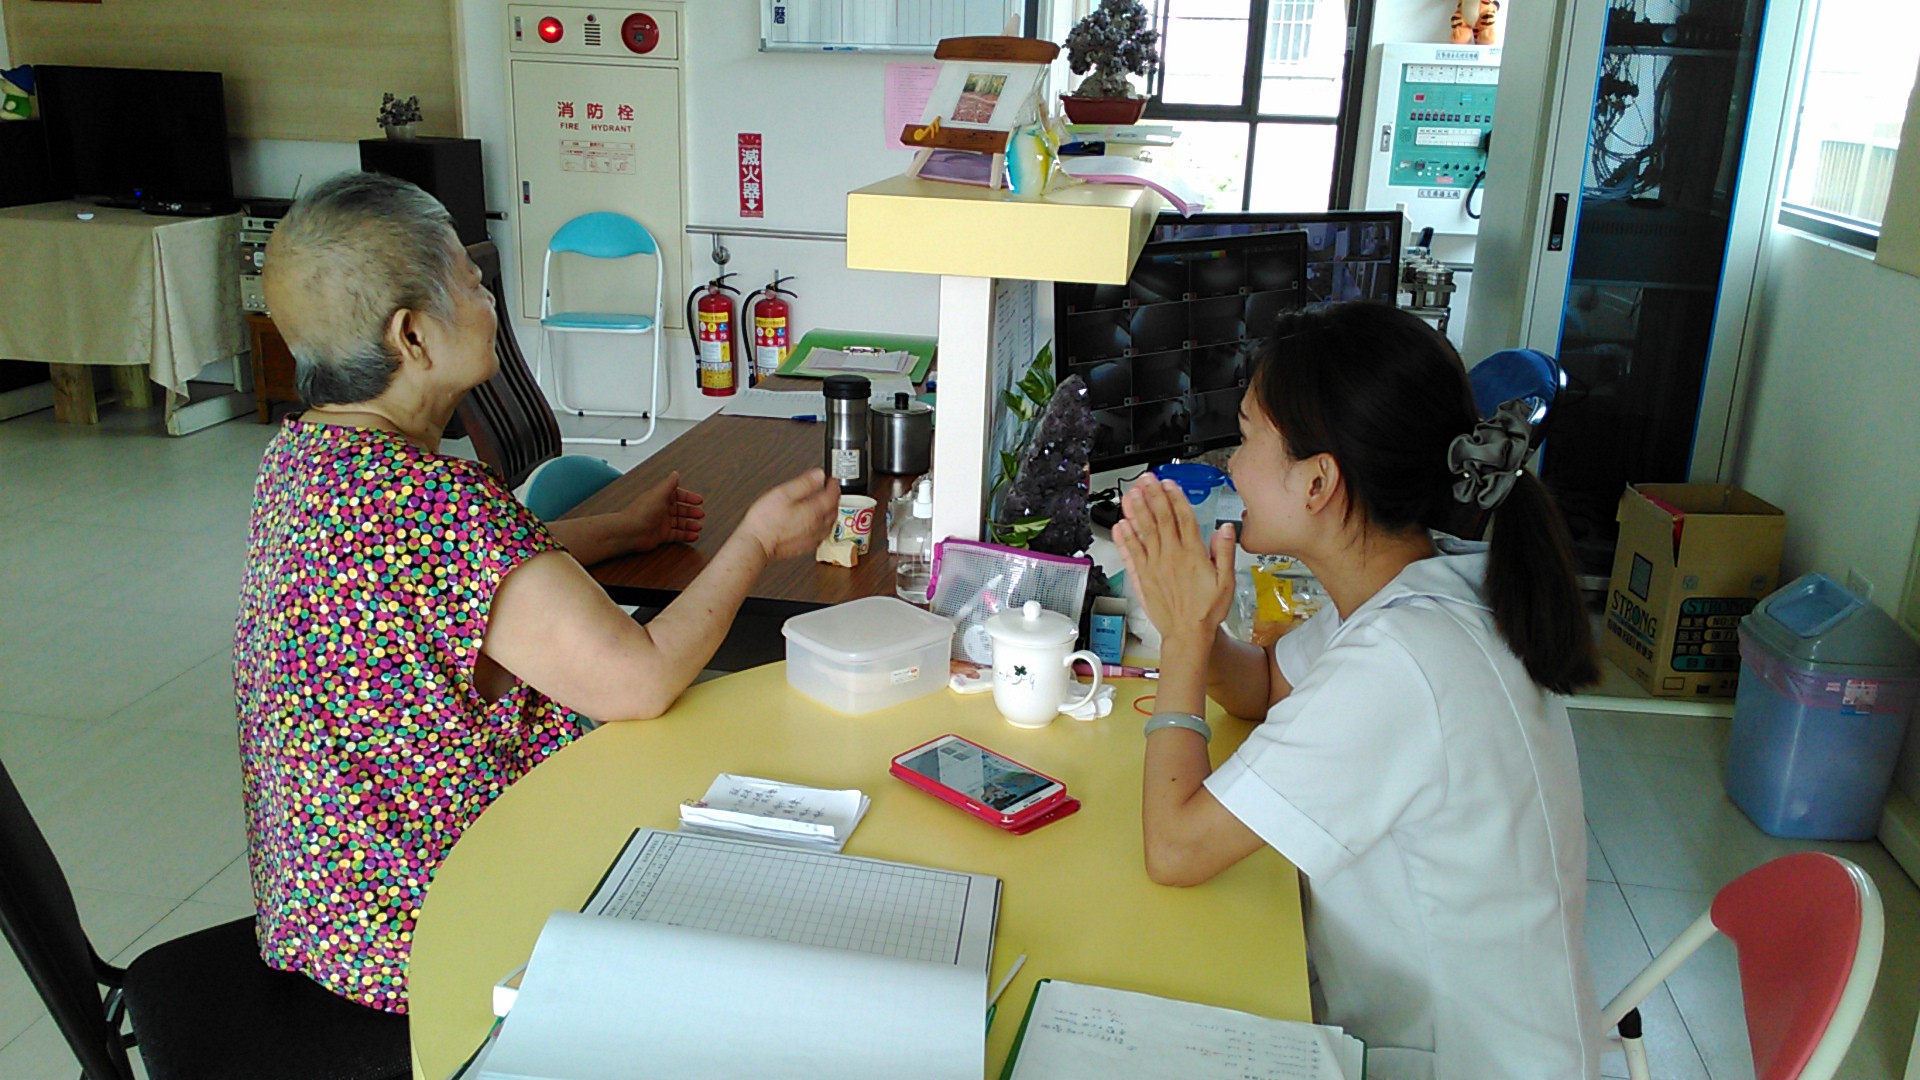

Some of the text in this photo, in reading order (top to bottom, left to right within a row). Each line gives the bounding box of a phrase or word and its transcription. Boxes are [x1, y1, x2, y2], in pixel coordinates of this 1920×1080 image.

[774, 0, 786, 24] 曆
[557, 101, 635, 121] 消防栓
[560, 122, 632, 133] FIRE HYDRANT
[741, 148, 761, 199] 滅火器
[1611, 589, 1658, 639] STRONG
